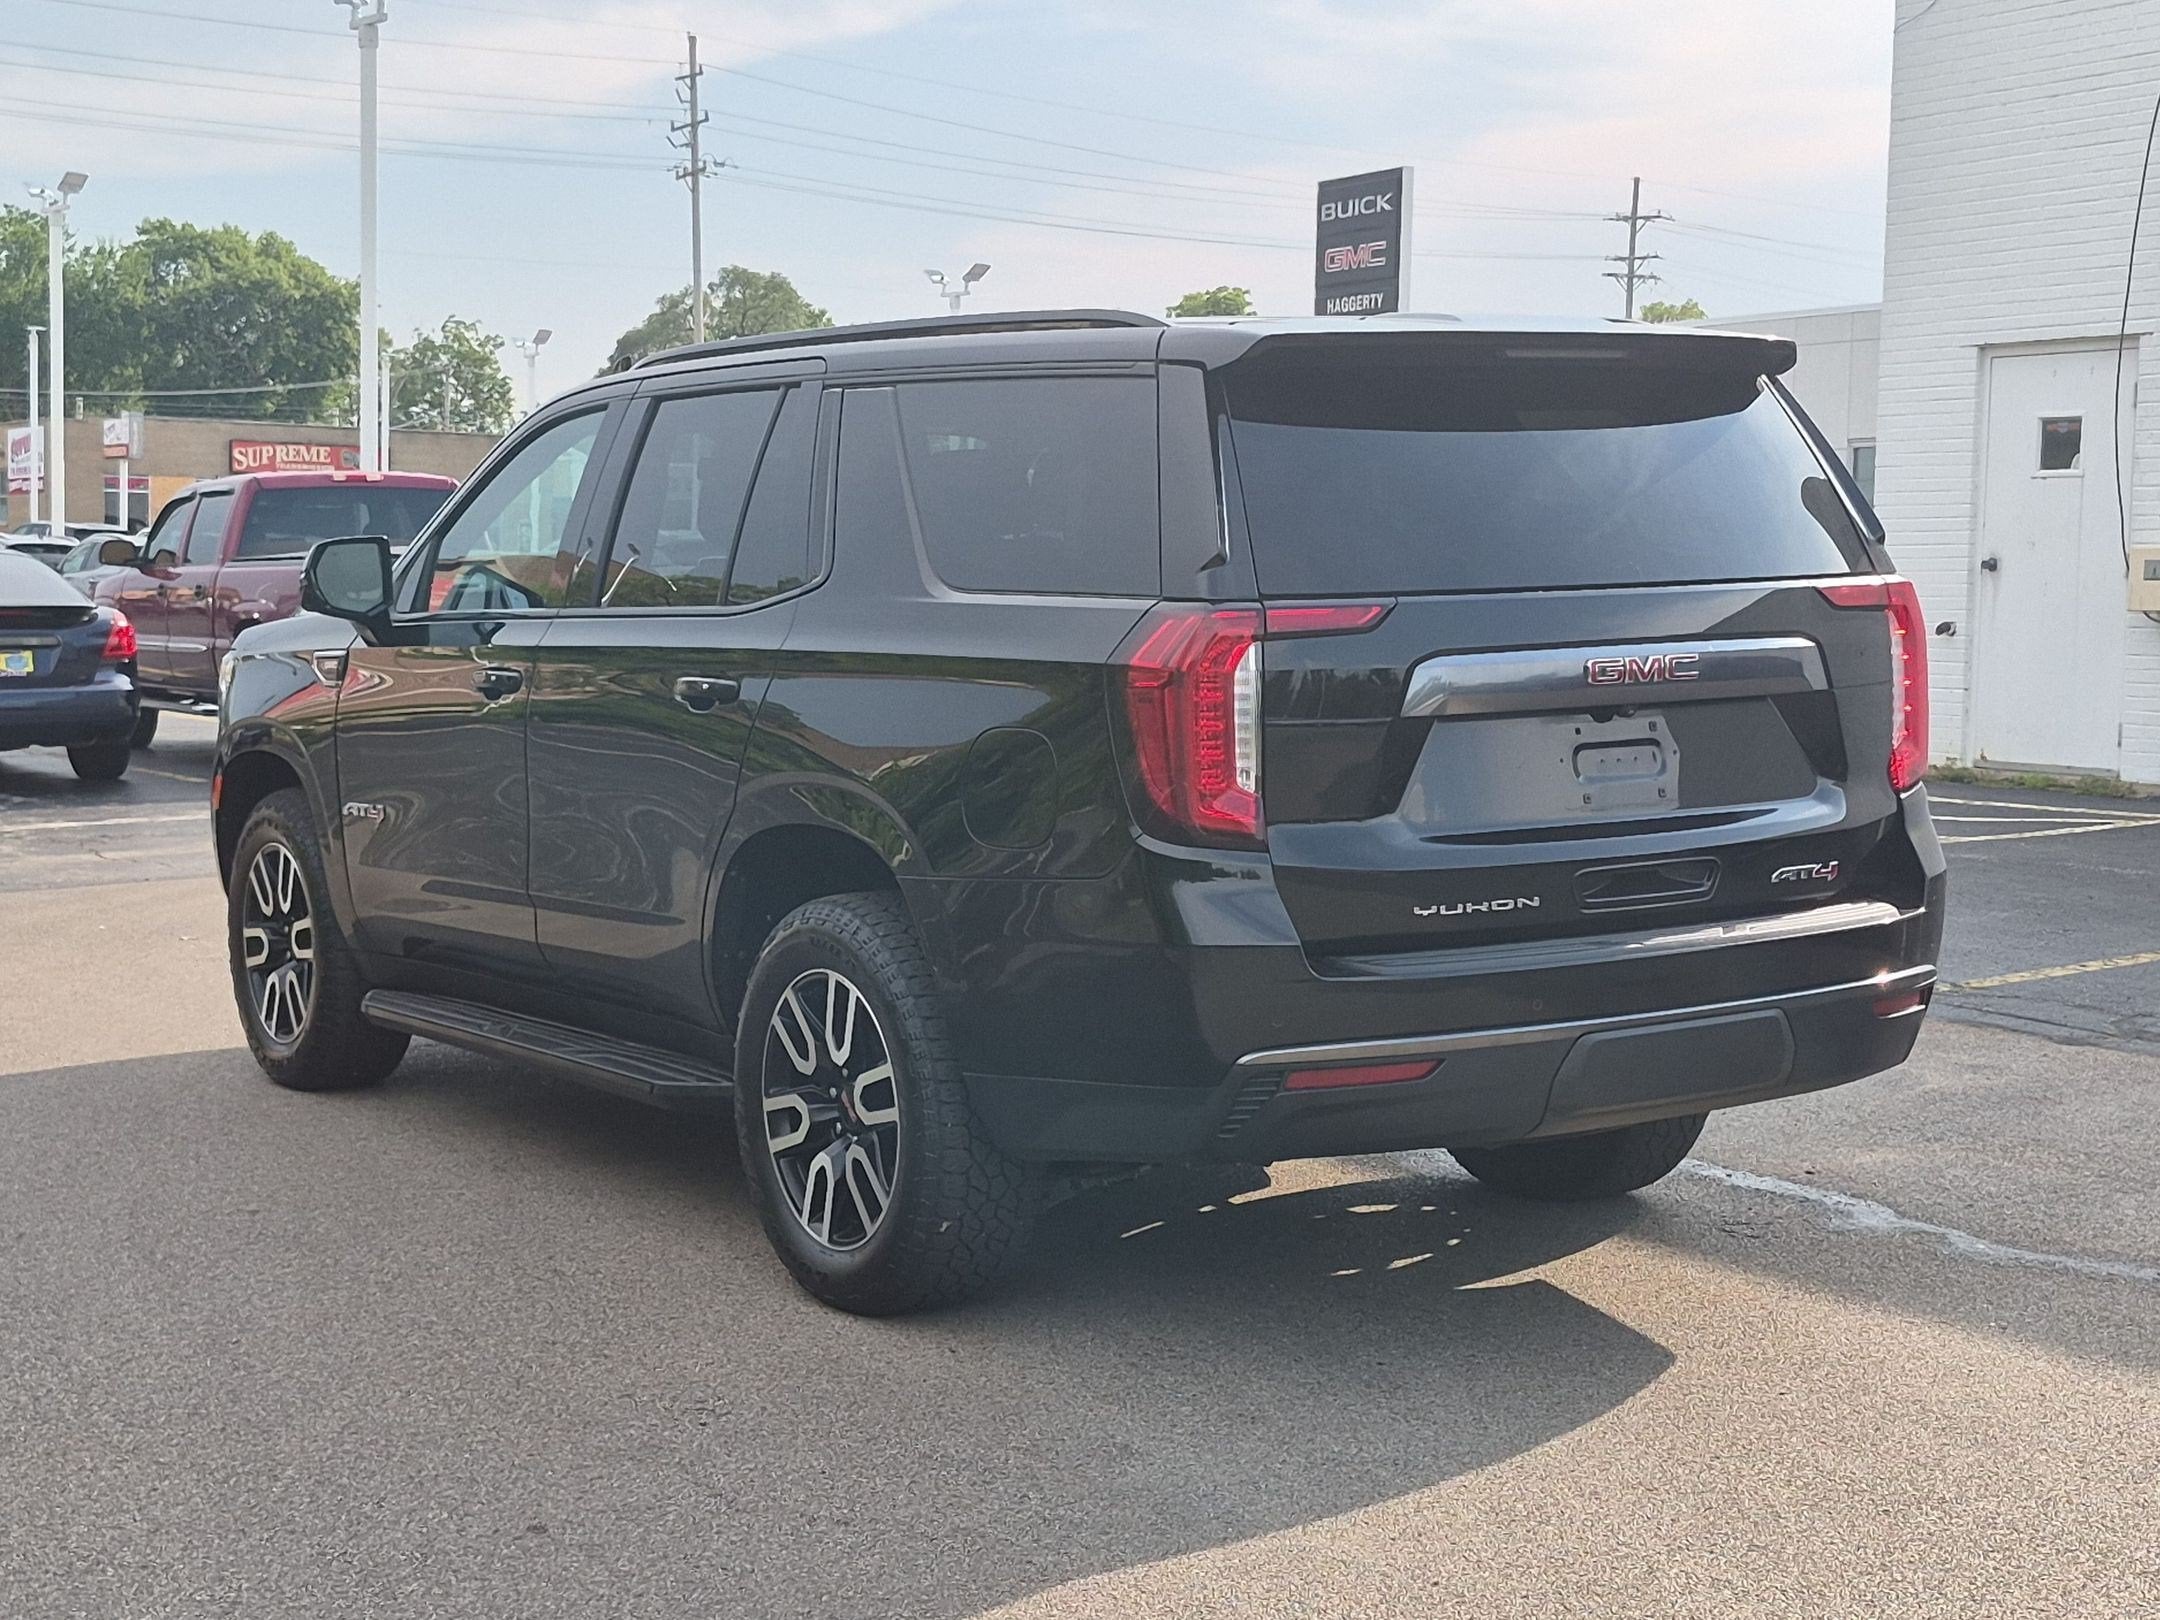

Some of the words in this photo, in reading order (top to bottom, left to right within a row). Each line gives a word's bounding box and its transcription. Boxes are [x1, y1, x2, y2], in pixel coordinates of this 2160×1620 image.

[1321, 192, 1393, 222] BUICK
[1324, 241, 1387, 273] GMC
[1327, 293, 1383, 315] HAGGERTY
[232, 445, 331, 470] SUPREME
[1586, 653, 1700, 685] GMC
[342, 802, 385, 823] AT4
[1771, 861, 1839, 883] AT4
[1413, 896, 1540, 916] YUKON
